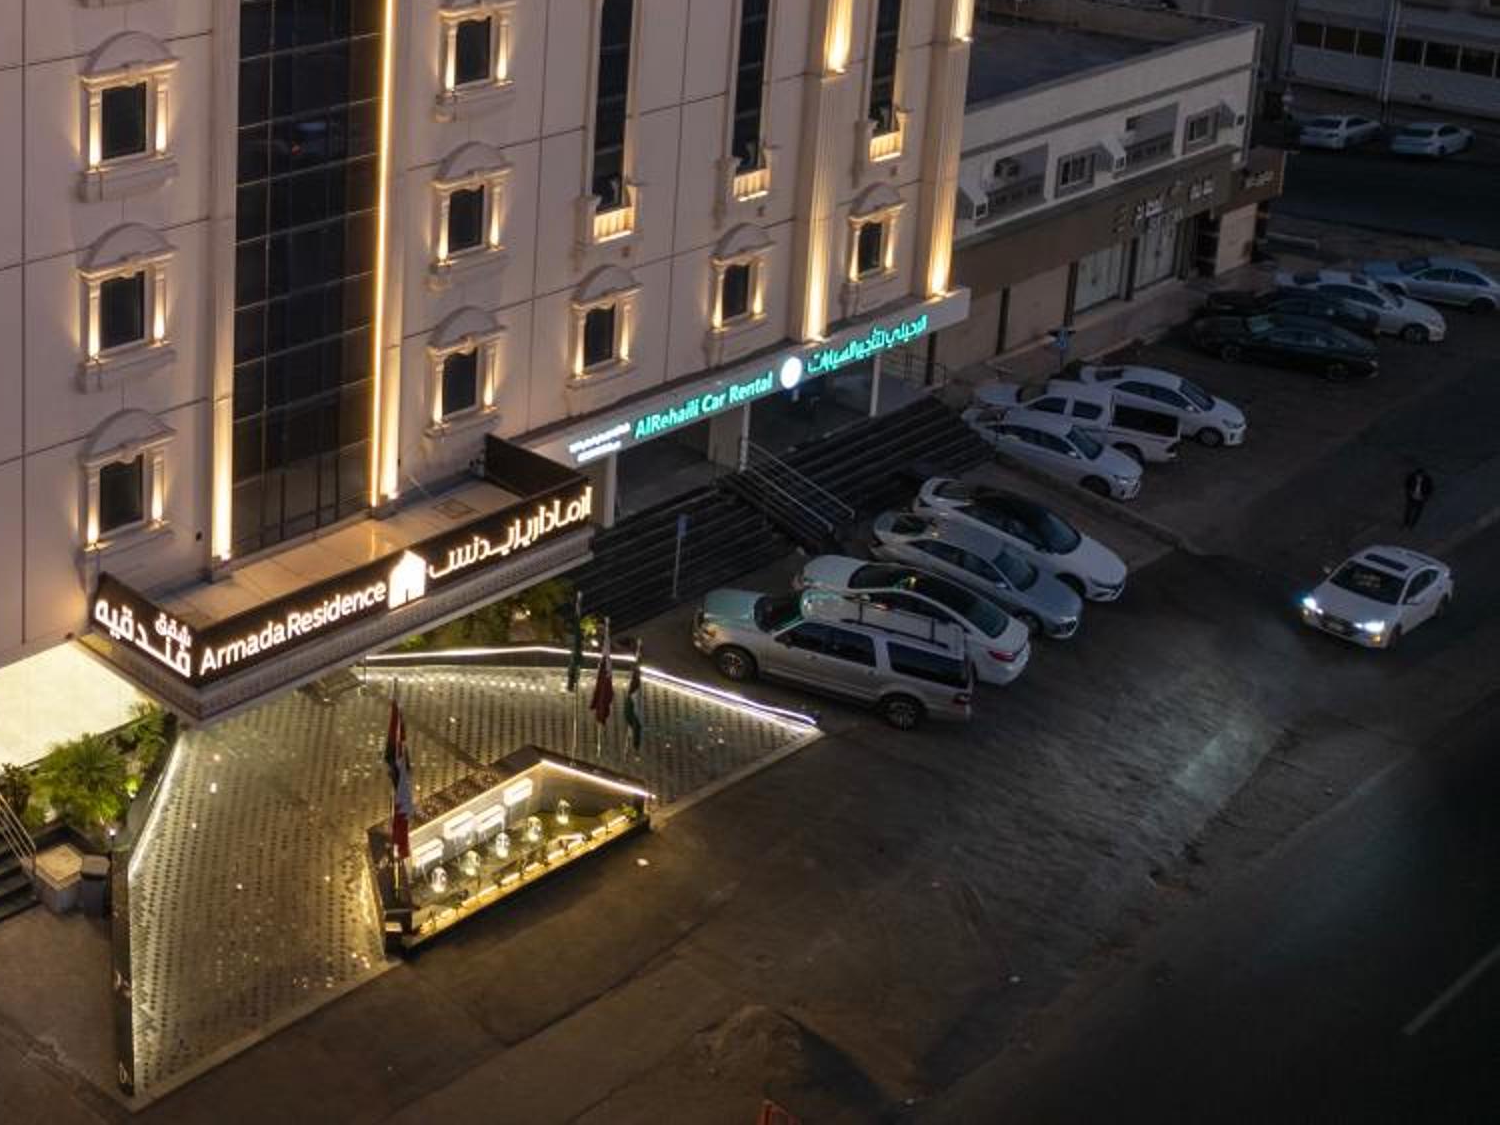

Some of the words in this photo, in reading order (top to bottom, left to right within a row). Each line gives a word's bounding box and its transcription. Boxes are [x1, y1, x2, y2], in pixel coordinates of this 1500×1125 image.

[701, 394, 726, 412] Car
[729, 371, 773, 403] Rental
[200, 621, 287, 675] Armada
[286, 581, 387, 639] Residence
